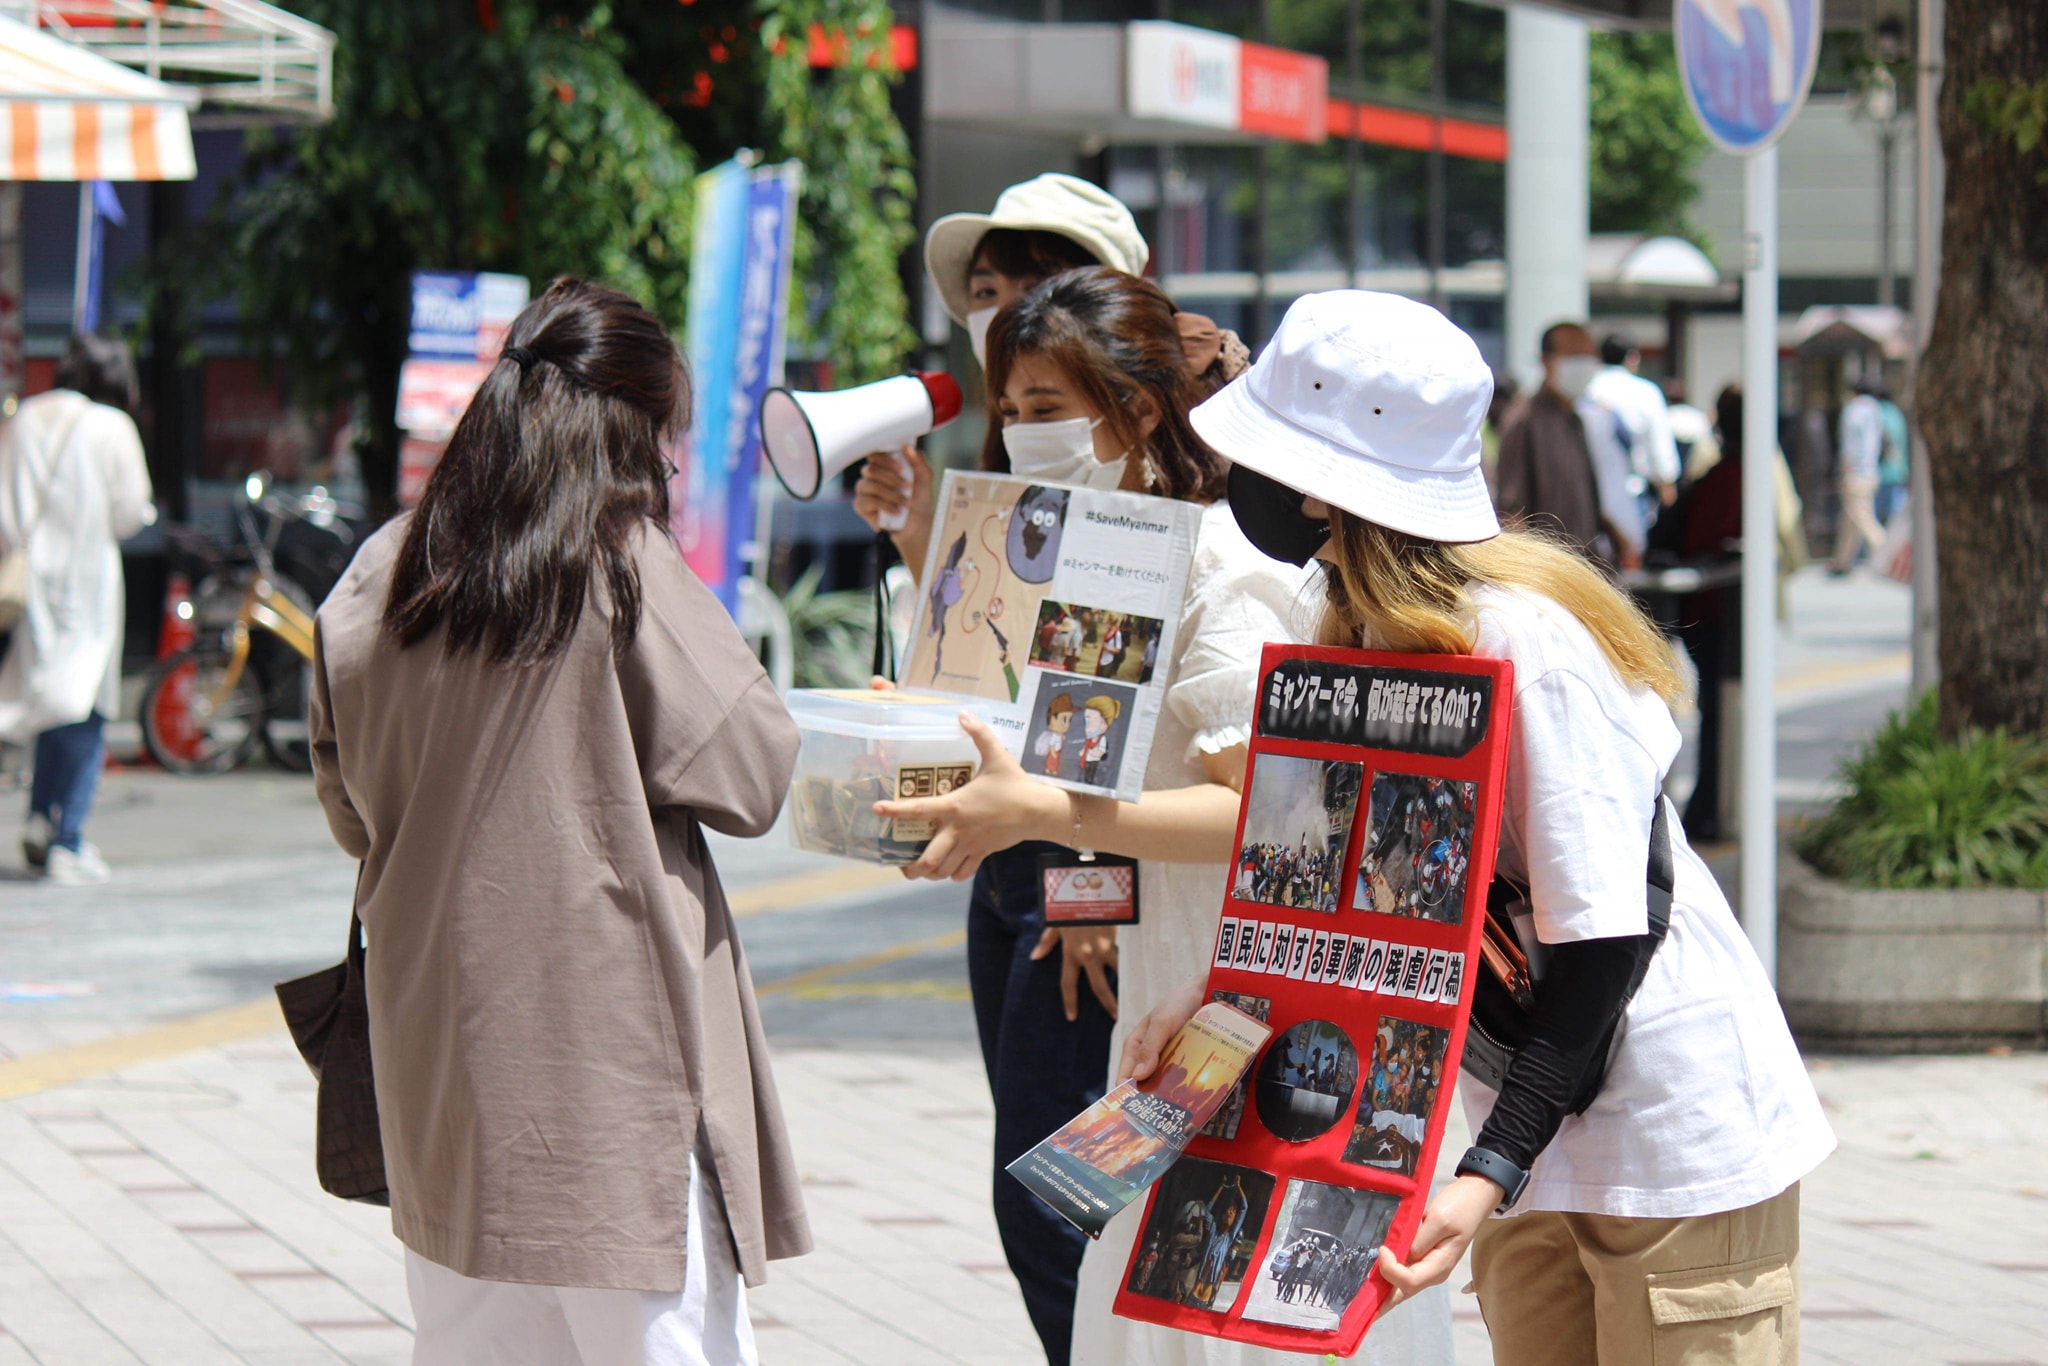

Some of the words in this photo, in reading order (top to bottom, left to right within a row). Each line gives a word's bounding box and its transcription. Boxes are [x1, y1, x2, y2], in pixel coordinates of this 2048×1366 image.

[1085, 510, 1169, 534] #SaveMyanmar
[991, 715, 1026, 731] anmar
[1216, 923, 1461, 998] 国民に対する軍隊の残虐行為
